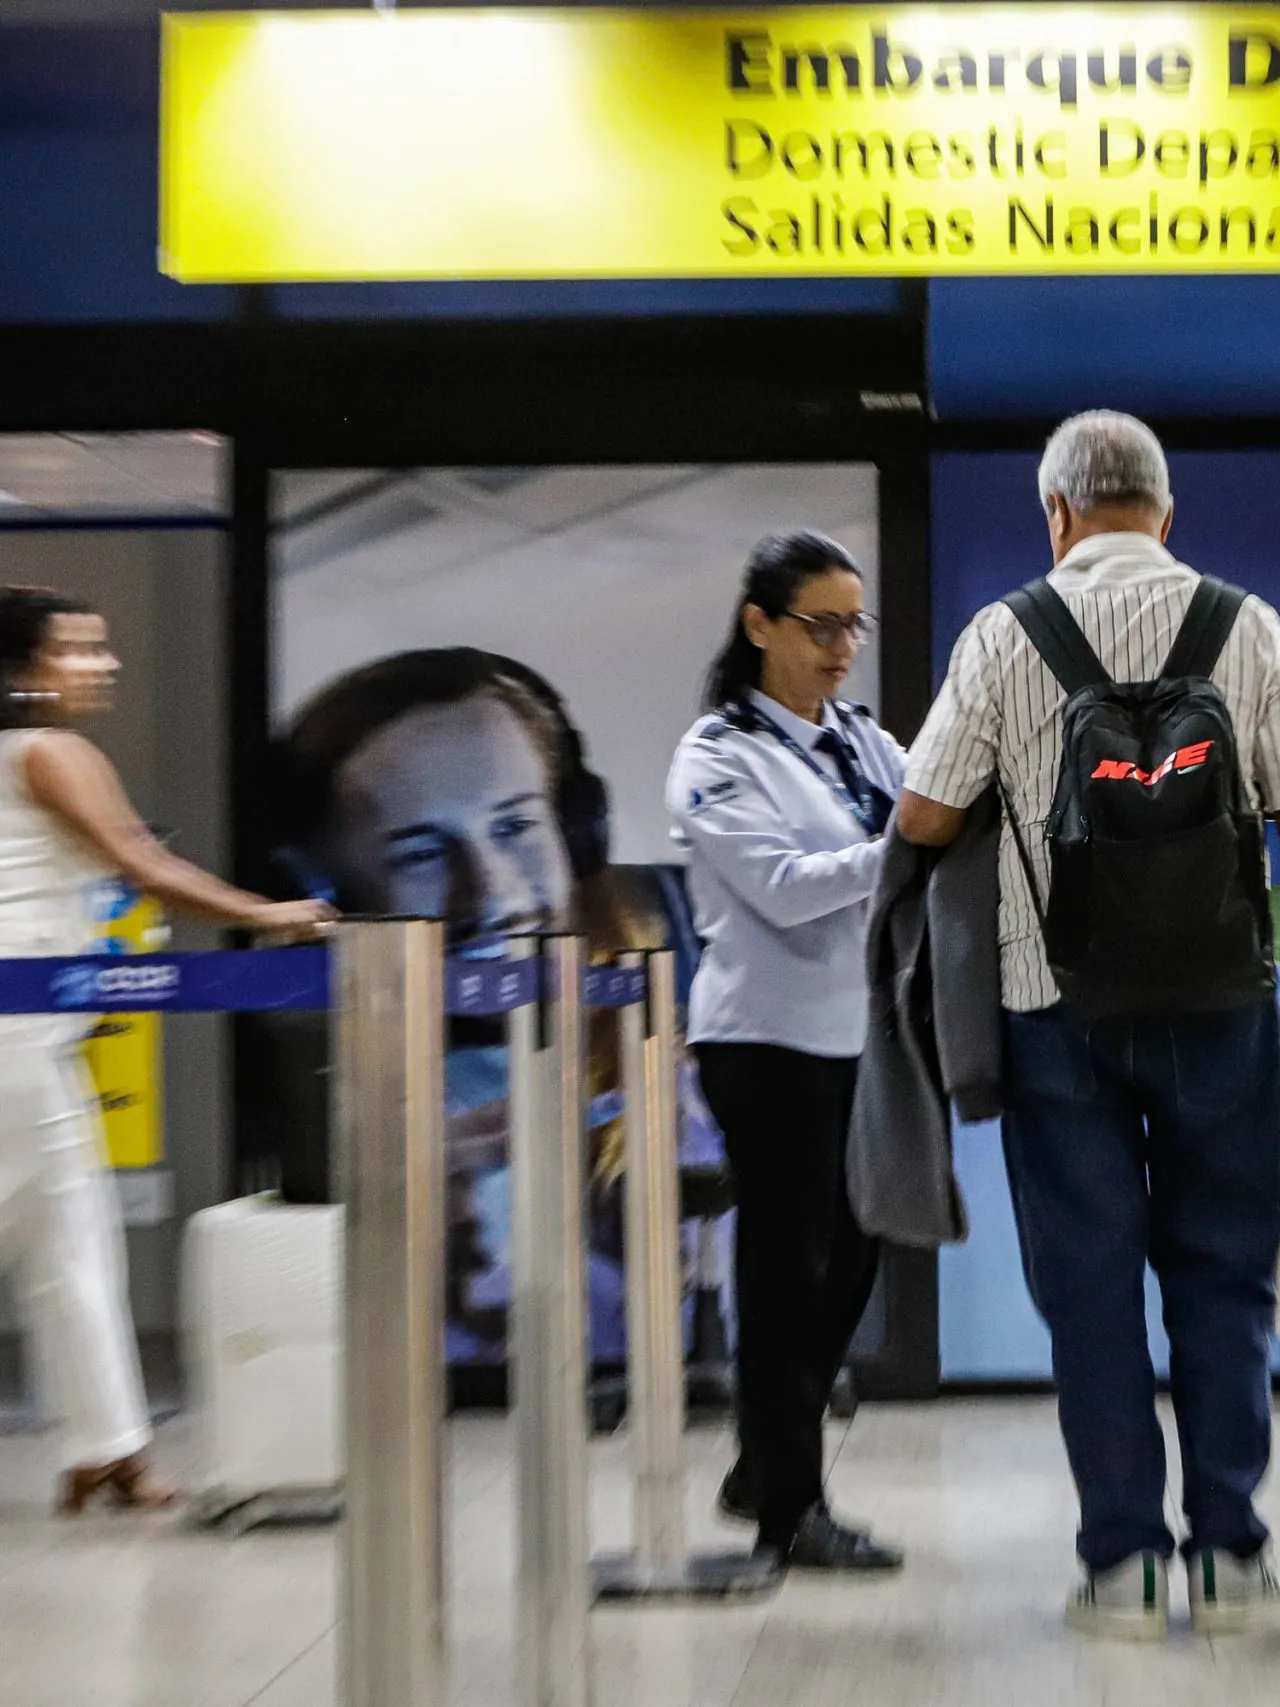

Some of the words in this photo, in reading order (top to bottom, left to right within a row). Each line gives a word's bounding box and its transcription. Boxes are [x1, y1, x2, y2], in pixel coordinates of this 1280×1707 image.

[726, 23, 1193, 113] Embarque
[724, 114, 1068, 180] Domestic
[721, 192, 977, 257] Salidas
